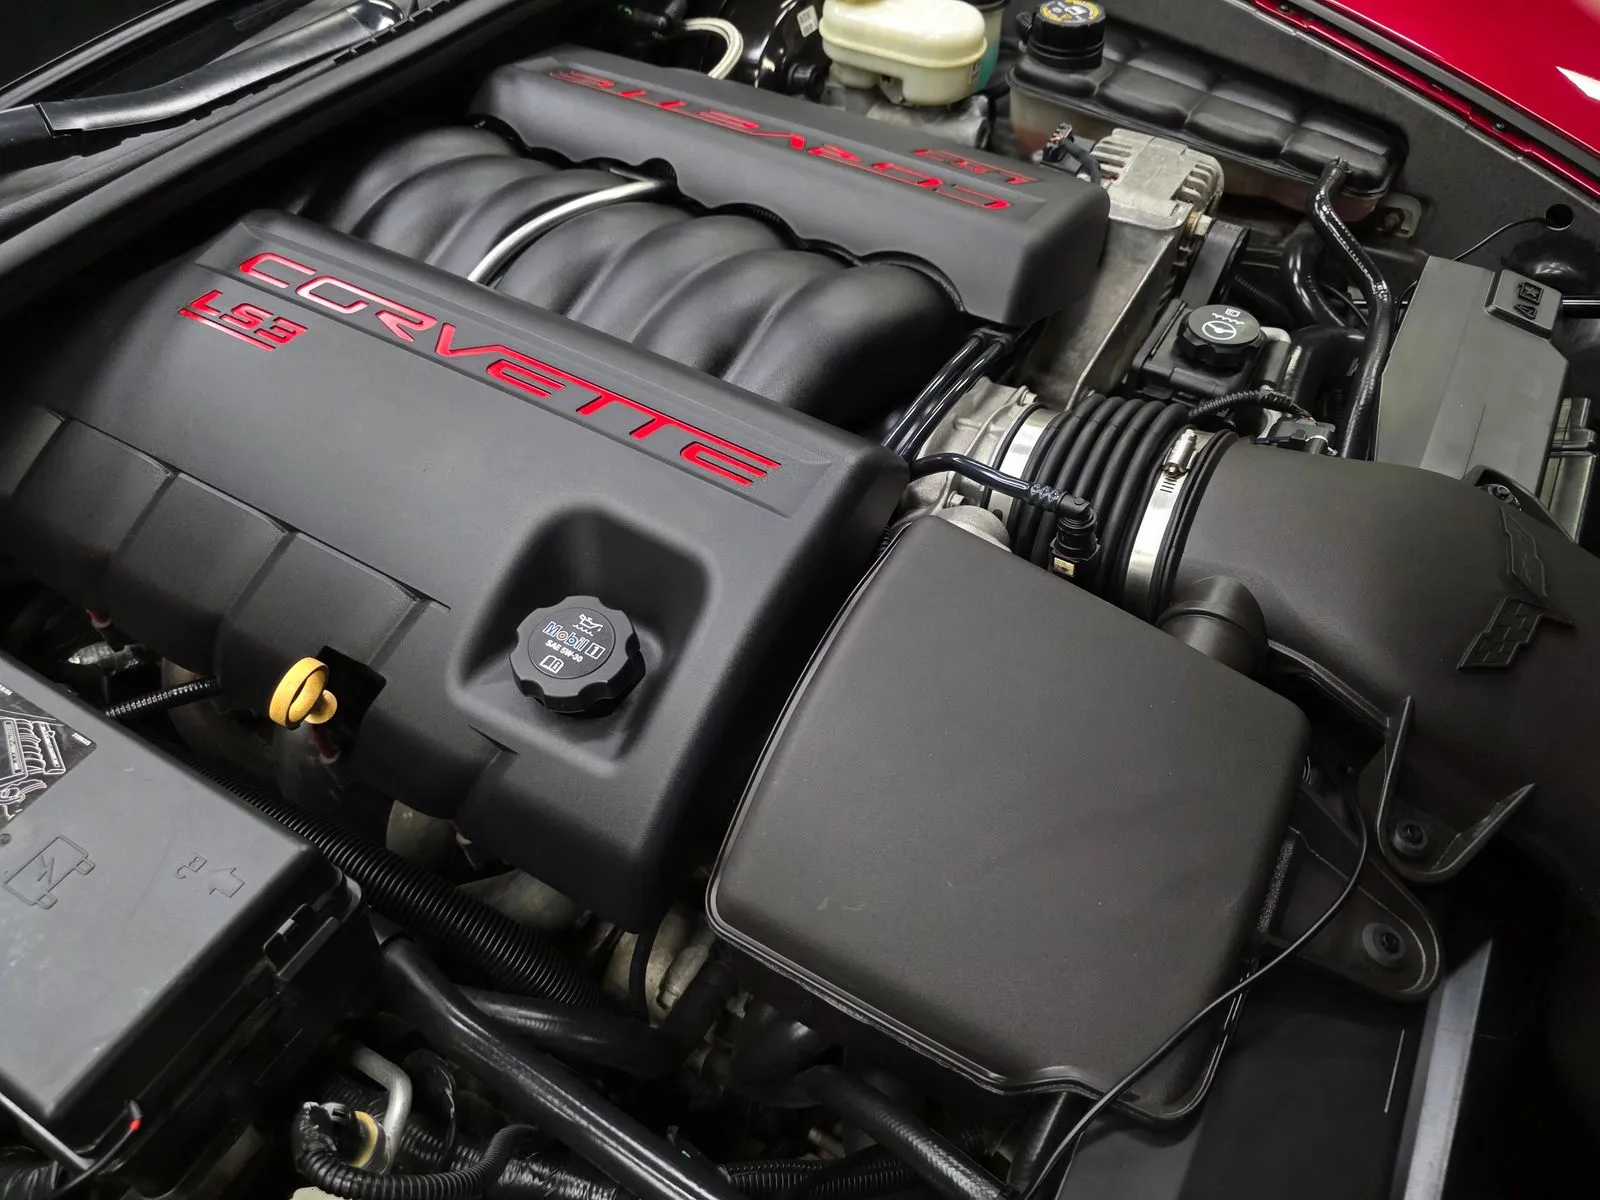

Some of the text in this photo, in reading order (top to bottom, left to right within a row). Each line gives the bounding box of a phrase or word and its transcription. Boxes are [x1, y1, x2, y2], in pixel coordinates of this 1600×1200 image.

[549, 70, 1010, 210] CORVETTE
[189, 289, 309, 346] LS3
[239, 252, 781, 487] CORVETTE
[542, 620, 590, 652] Mobil
[545, 639, 584, 662] SAE 5W-30
